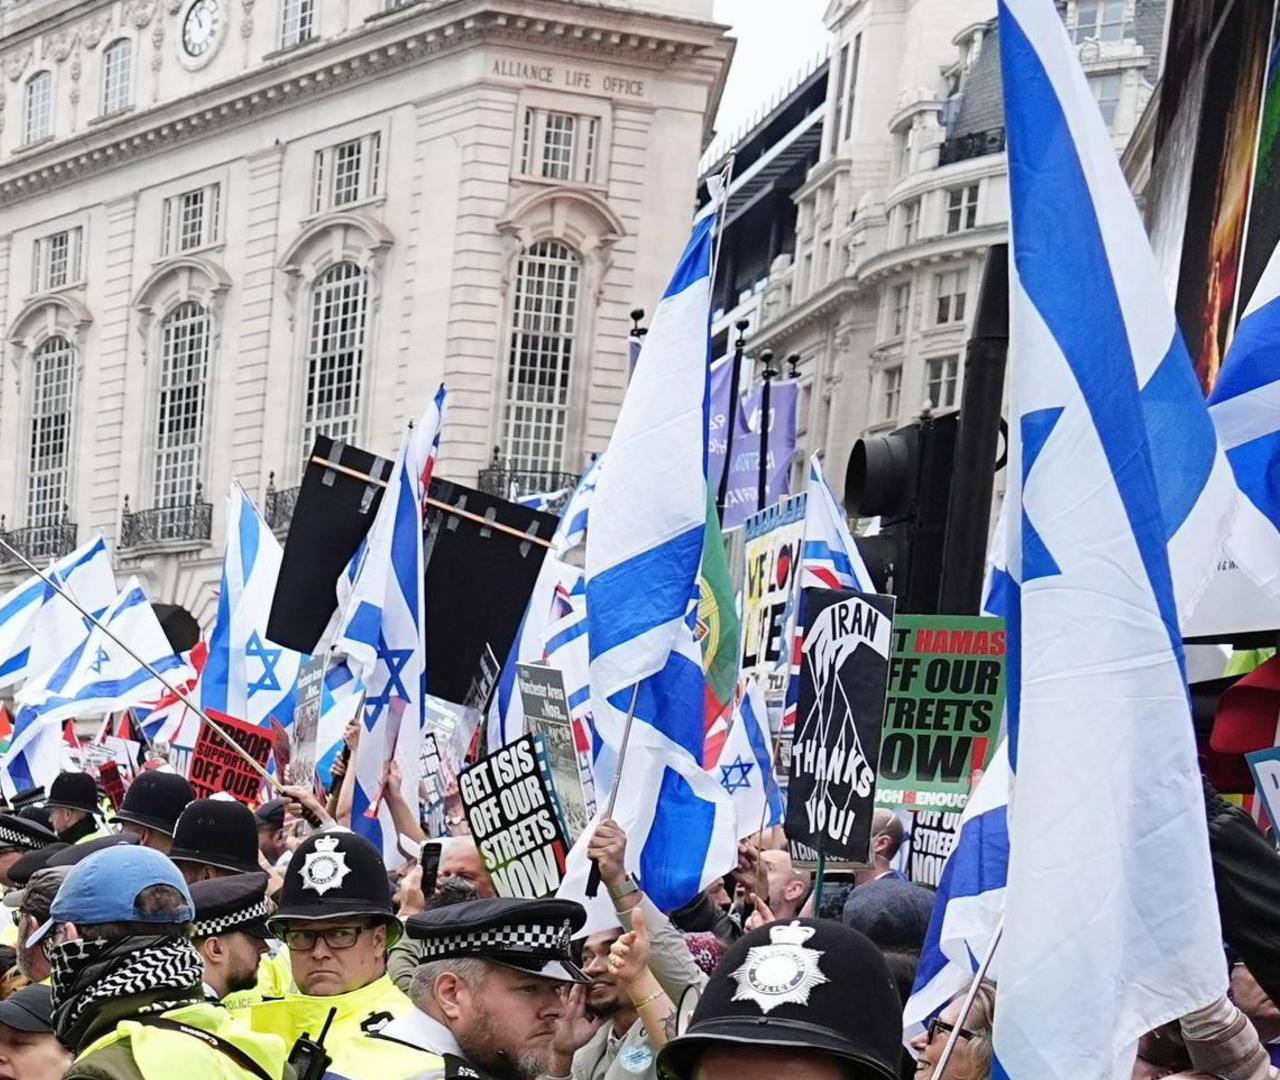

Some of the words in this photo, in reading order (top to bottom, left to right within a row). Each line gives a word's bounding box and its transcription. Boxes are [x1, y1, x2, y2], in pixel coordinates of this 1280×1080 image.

[492, 59, 553, 83] ALLIANCE
[565, 70, 591, 89] LIFE
[603, 76, 644, 97] OFFICE
[831, 603, 878, 642] IRAN
[915, 629, 1006, 656] HAMAS
[924, 659, 1001, 695] OUR
[196, 742, 263, 778] SUPPORTERS
[200, 717, 273, 764] TERROR
[191, 757, 221, 785] OFF
[221, 768, 261, 801] OUR
[459, 761, 491, 806] GET
[490, 739, 535, 788] ISIS
[793, 738, 875, 799] THANKS
[469, 800, 501, 839] OFF
[500, 775, 546, 822] OUR
[805, 797, 856, 846] YOU!
[480, 808, 557, 871] STREETS
[223, 998, 255, 1010] POLICE
